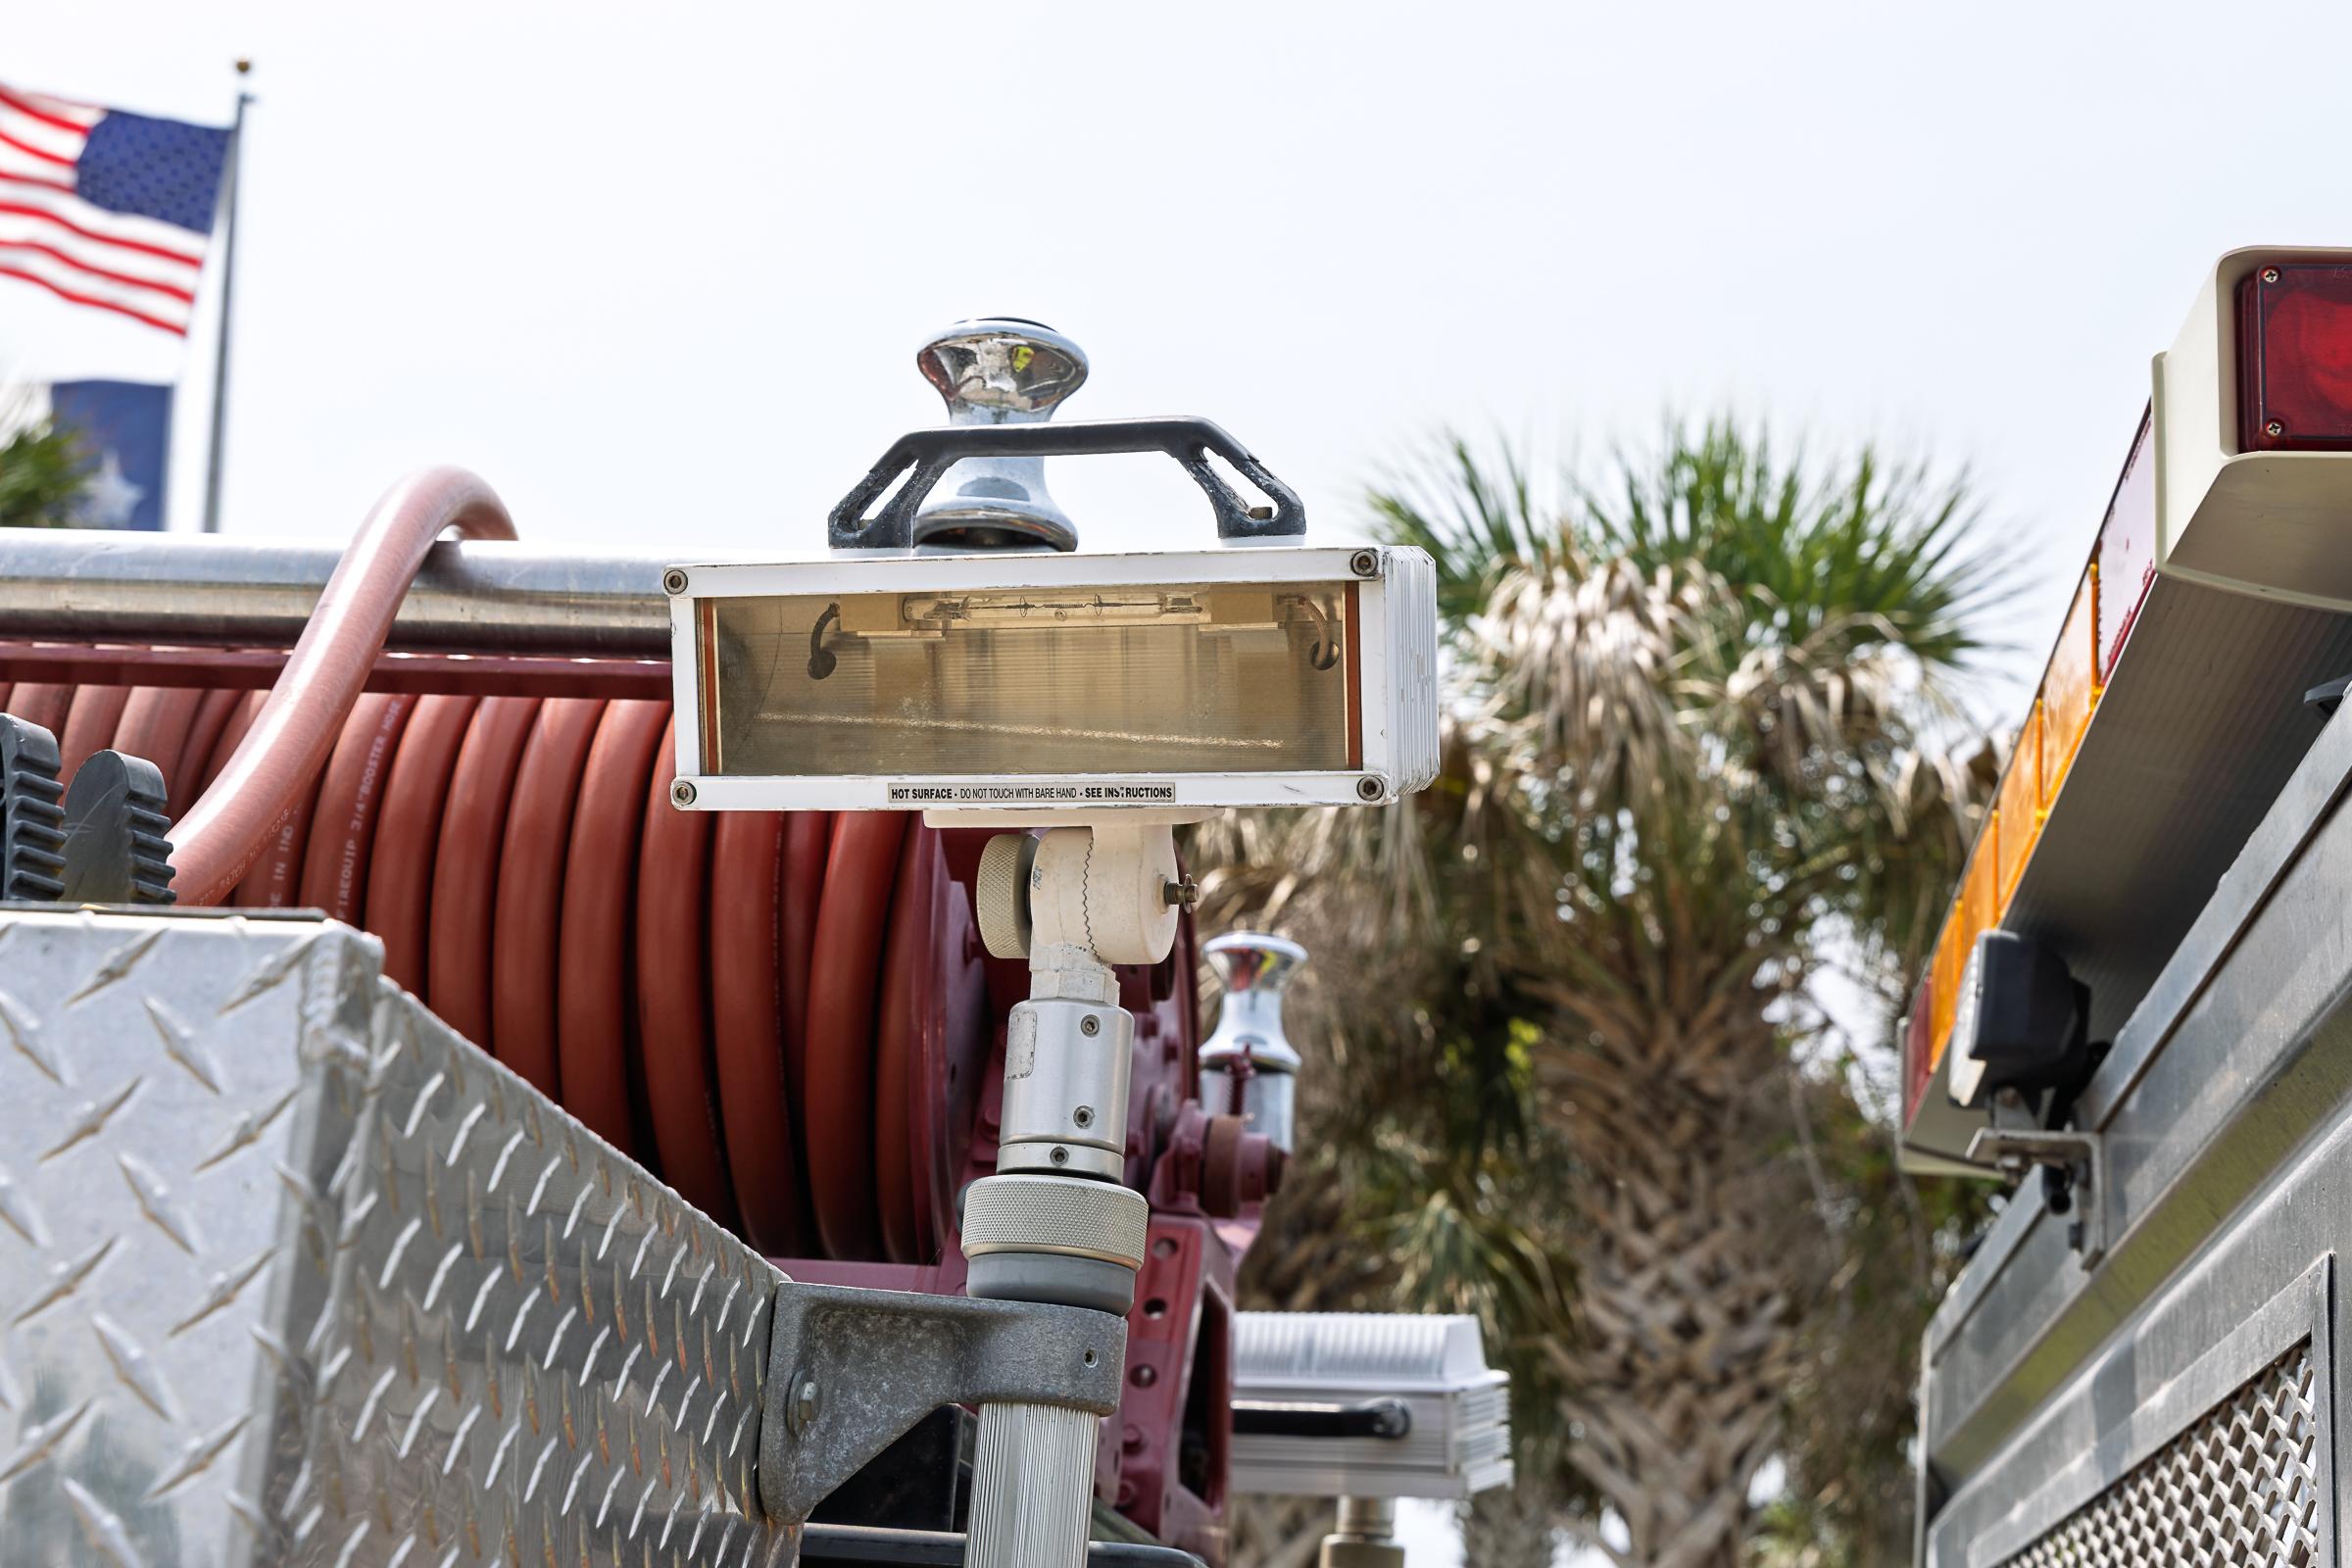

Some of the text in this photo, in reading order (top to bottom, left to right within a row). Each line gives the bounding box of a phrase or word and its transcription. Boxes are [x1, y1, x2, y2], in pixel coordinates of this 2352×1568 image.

[891, 788, 909, 800] HOT
[911, 788, 953, 800] SURFACE
[960, 788, 971, 800] DO
[972, 788, 987, 800] NOT
[989, 788, 1014, 800] TOUCH
[1015, 788, 1034, 800] WITH
[1035, 788, 1054, 799] BARE
[1055, 787, 1077, 799] HAND
[1085, 787, 1102, 799] SEE
